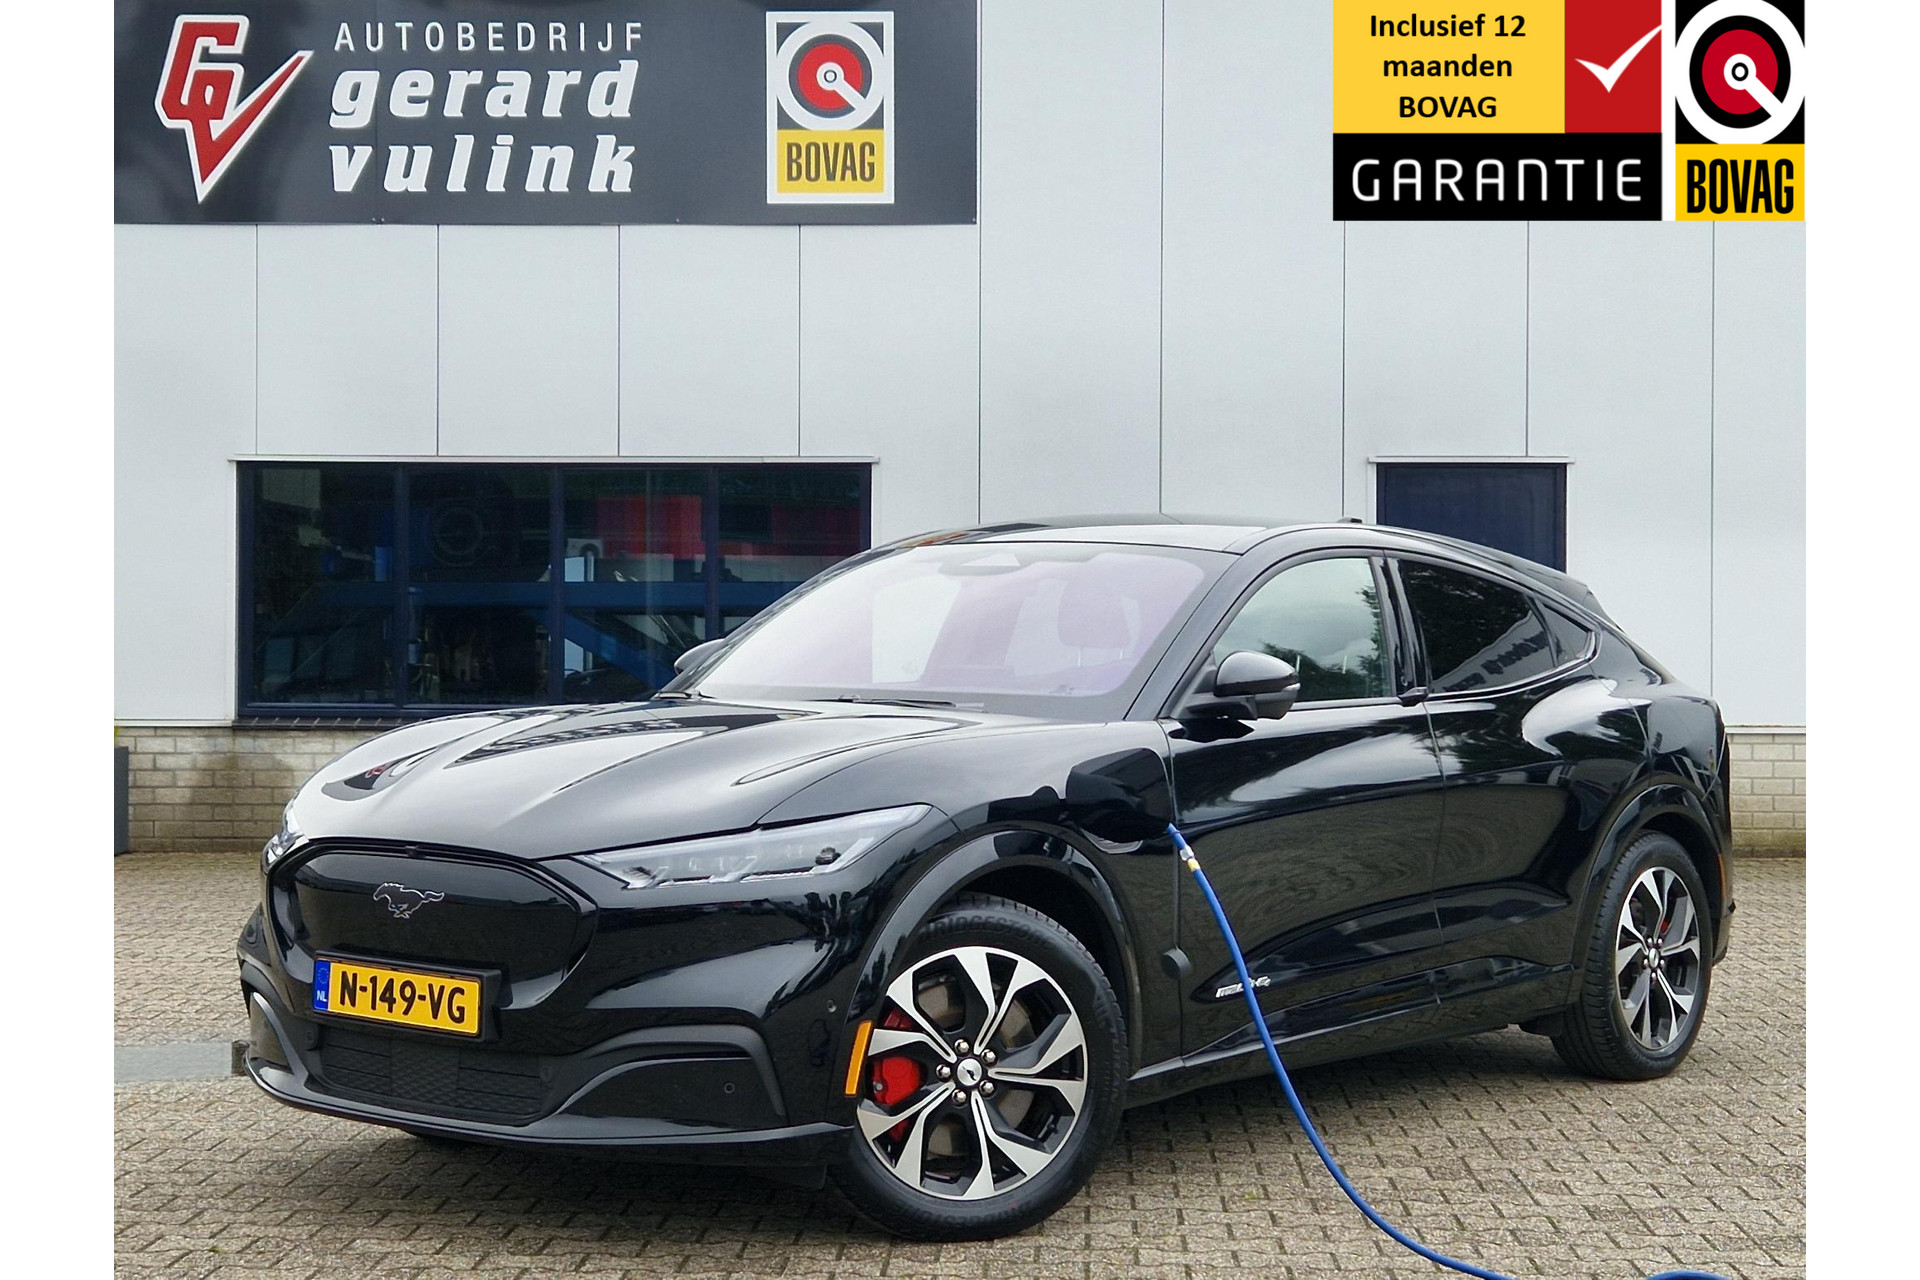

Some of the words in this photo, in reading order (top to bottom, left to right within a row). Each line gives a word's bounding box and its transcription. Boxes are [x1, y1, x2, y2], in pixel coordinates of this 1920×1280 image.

[334, 22, 642, 53] AUTOBEDRIJF
[329, 59, 638, 128] gerard
[329, 134, 636, 193] vulink
[787, 142, 875, 184] BOVAG
[316, 989, 327, 1002] NL
[340, 970, 466, 1024] N-149-VG
